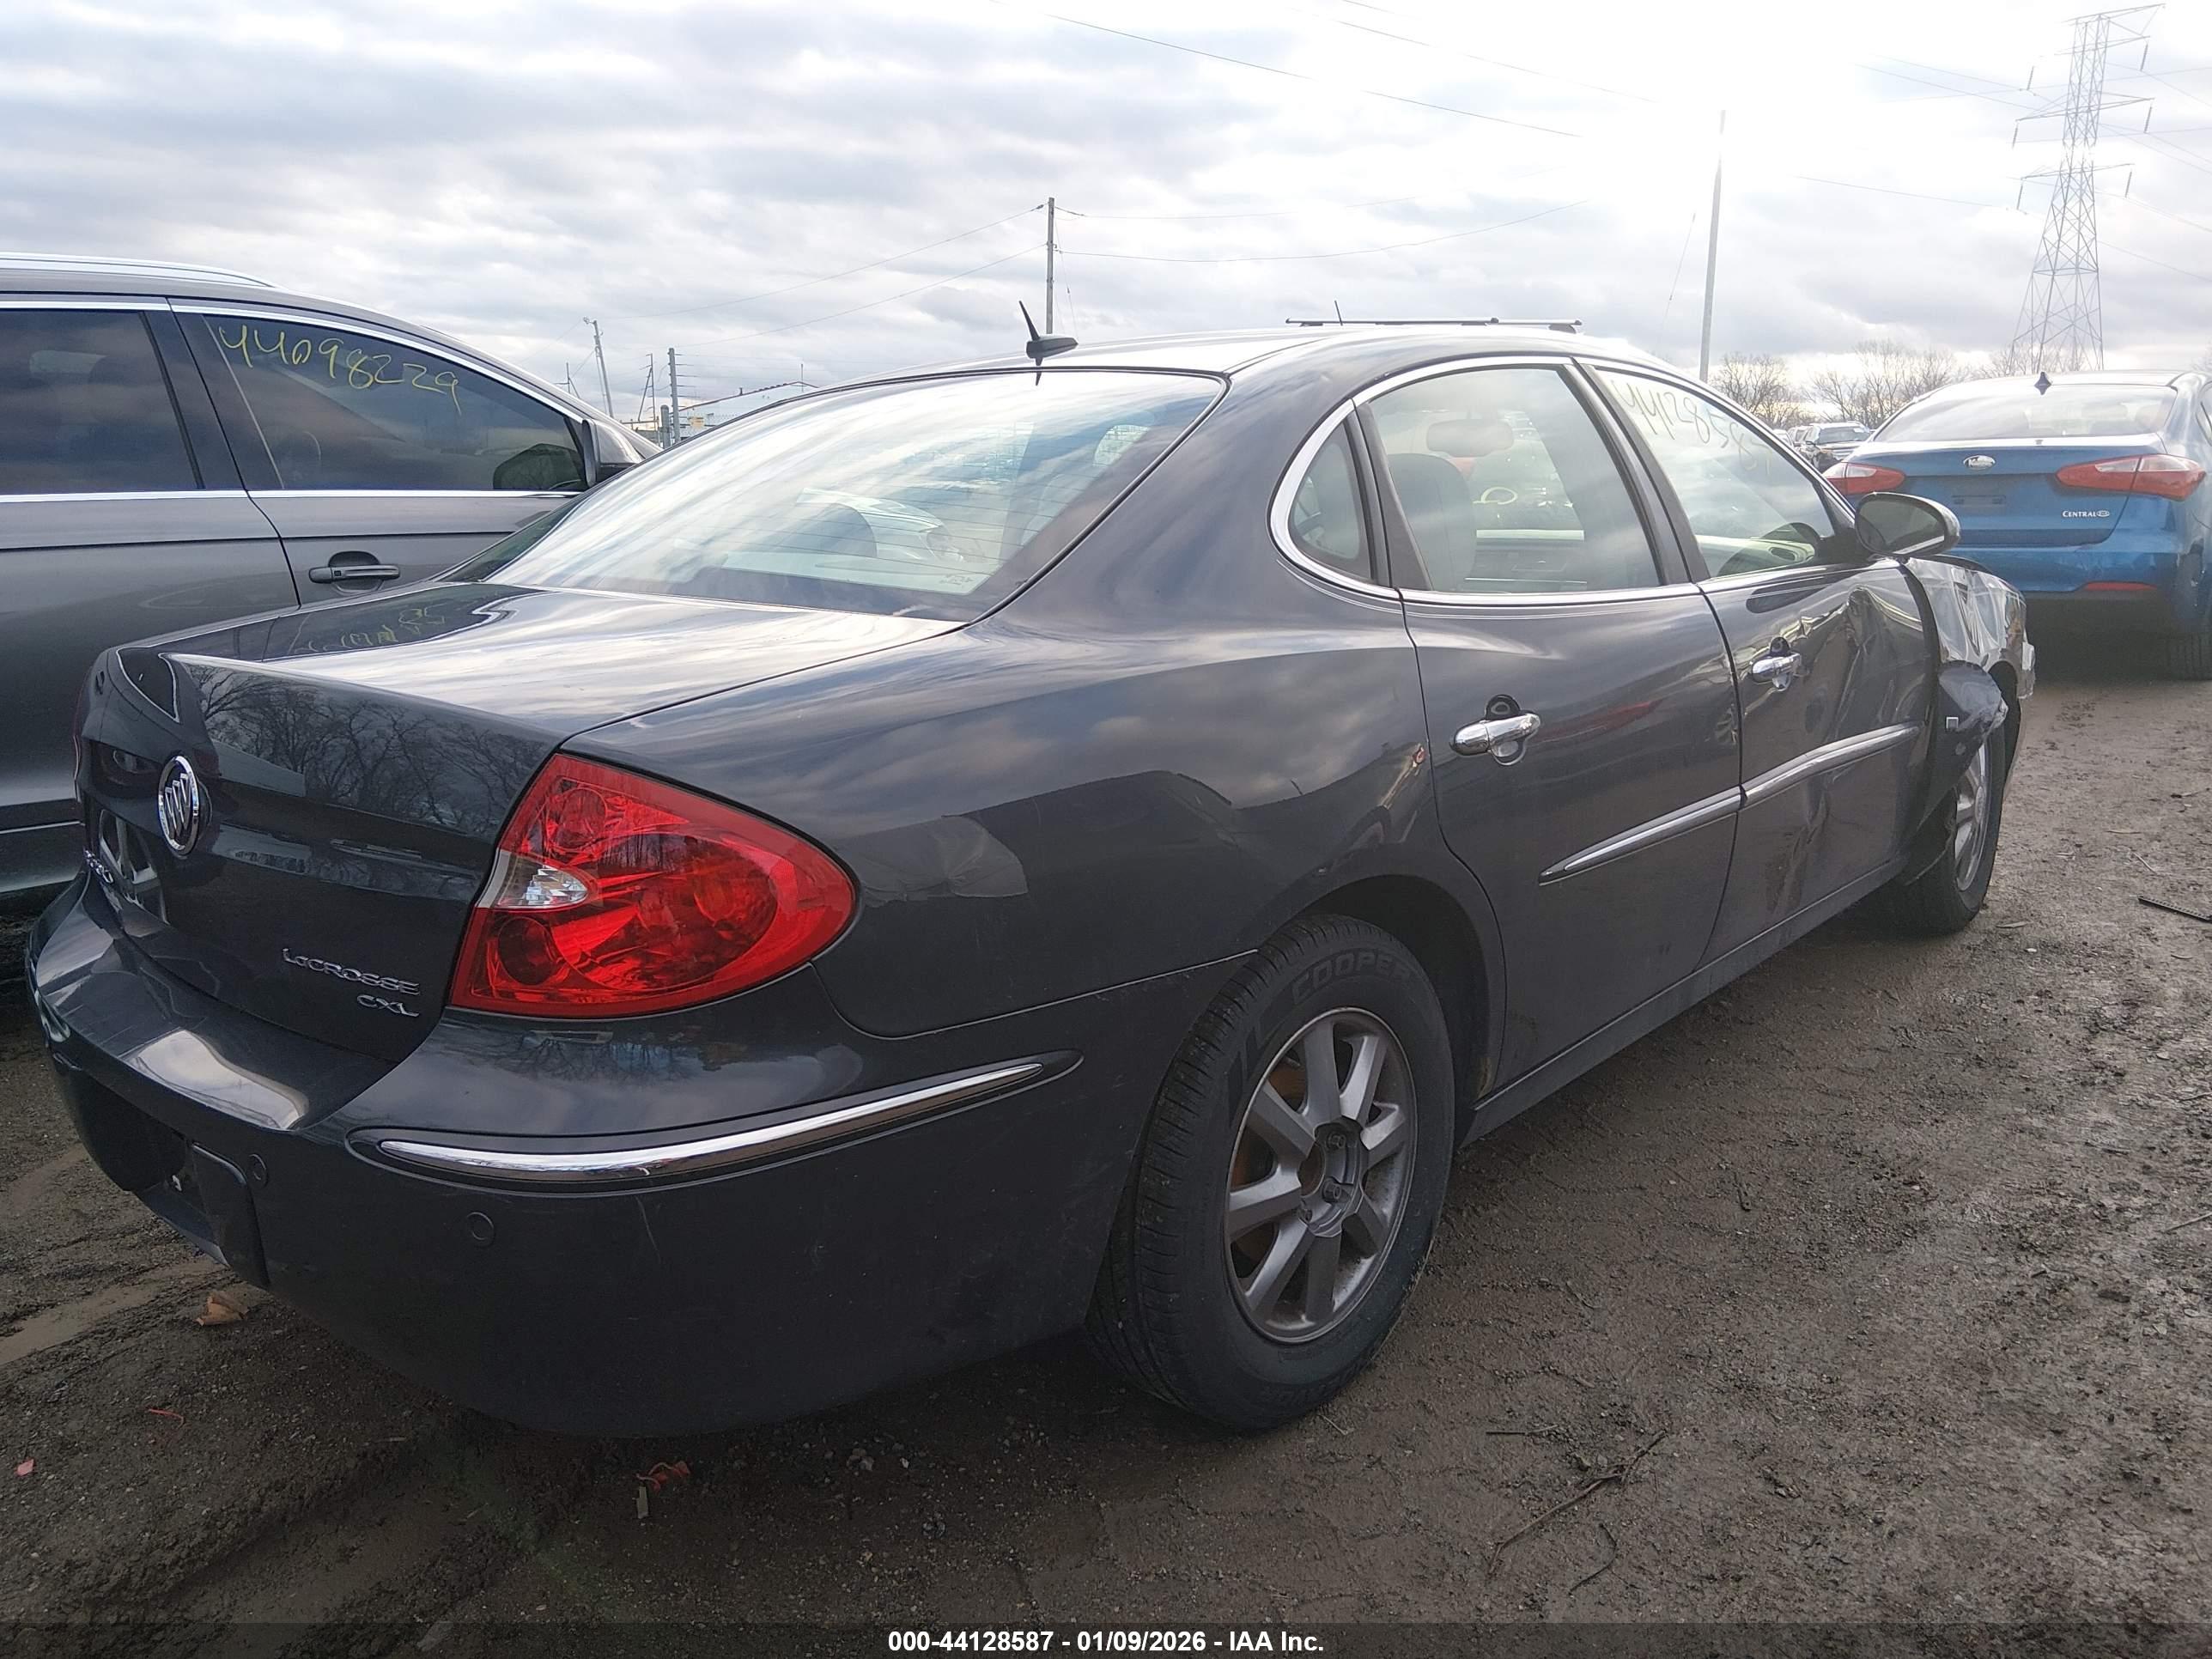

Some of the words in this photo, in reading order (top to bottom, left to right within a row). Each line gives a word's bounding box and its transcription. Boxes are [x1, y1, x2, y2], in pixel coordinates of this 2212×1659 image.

[217, 324, 462, 416] 44098229
[1291, 951, 1411, 1005] COOPER
[356, 994, 420, 1018] CXL
